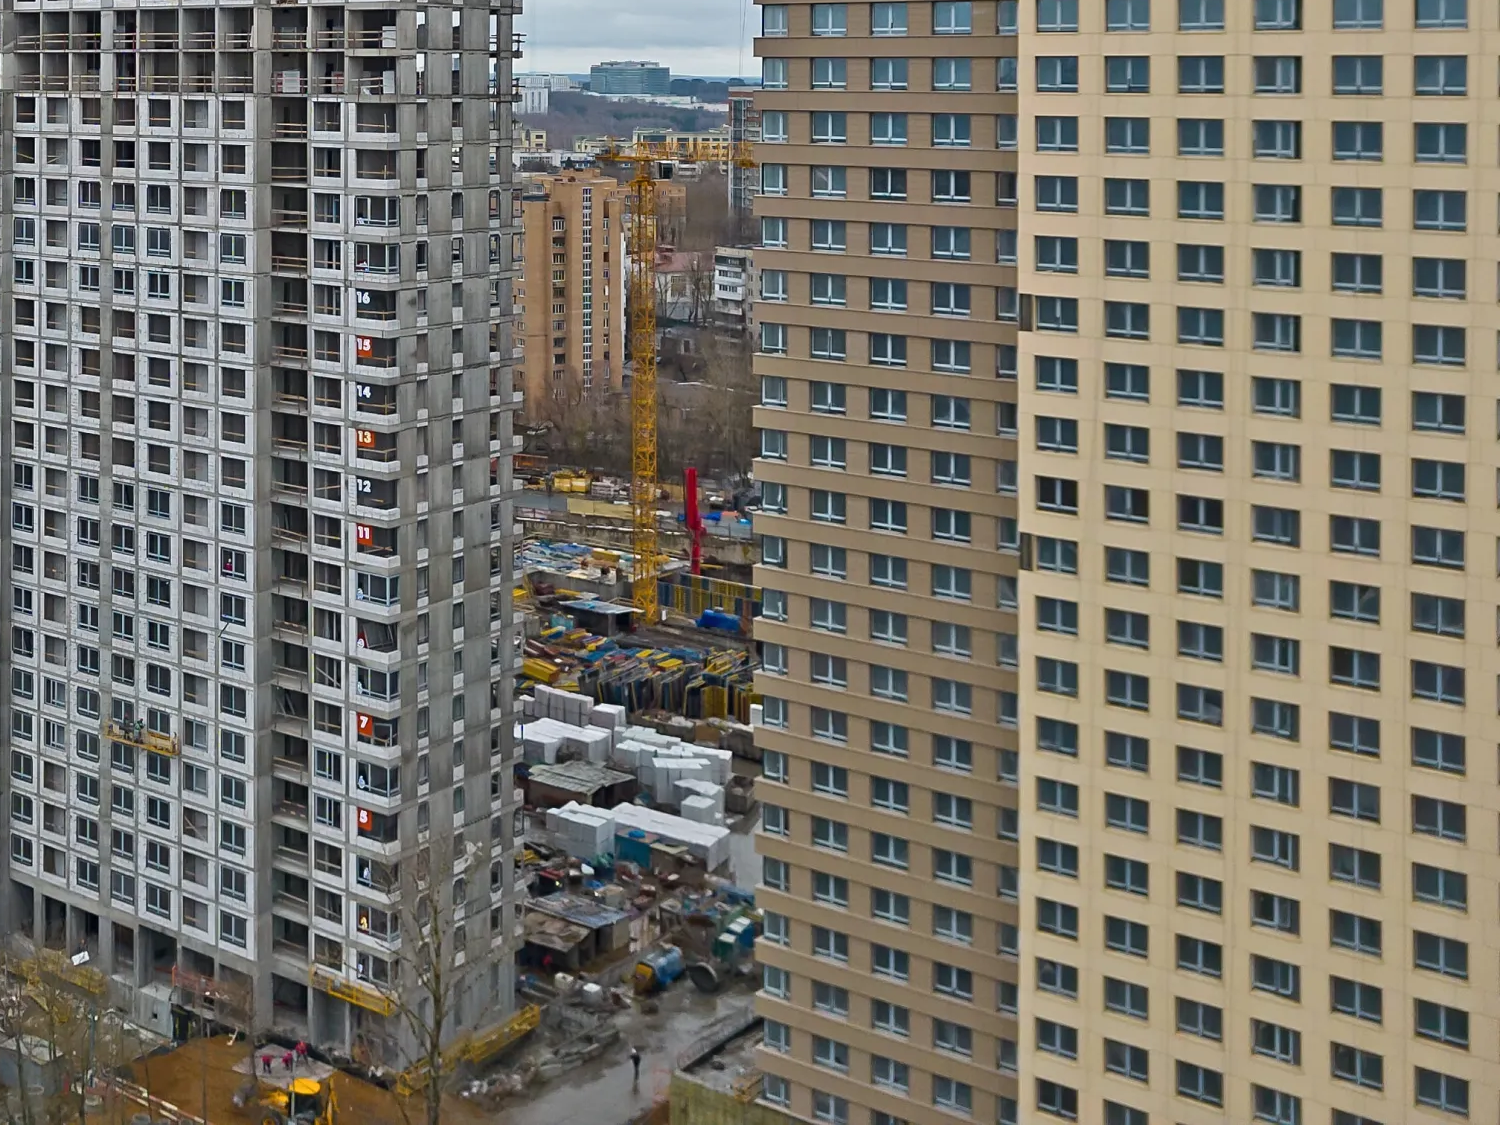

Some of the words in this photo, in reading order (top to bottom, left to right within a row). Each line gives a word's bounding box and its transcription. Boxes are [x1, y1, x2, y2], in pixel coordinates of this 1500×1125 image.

[356, 291, 371, 304] 16
[356, 338, 371, 351] 15
[357, 384, 371, 398] 14
[357, 431, 372, 444] 13
[356, 479, 372, 493] 12
[357, 526, 371, 539] 11
[359, 715, 369, 729] 7
[359, 810, 368, 823] 5
